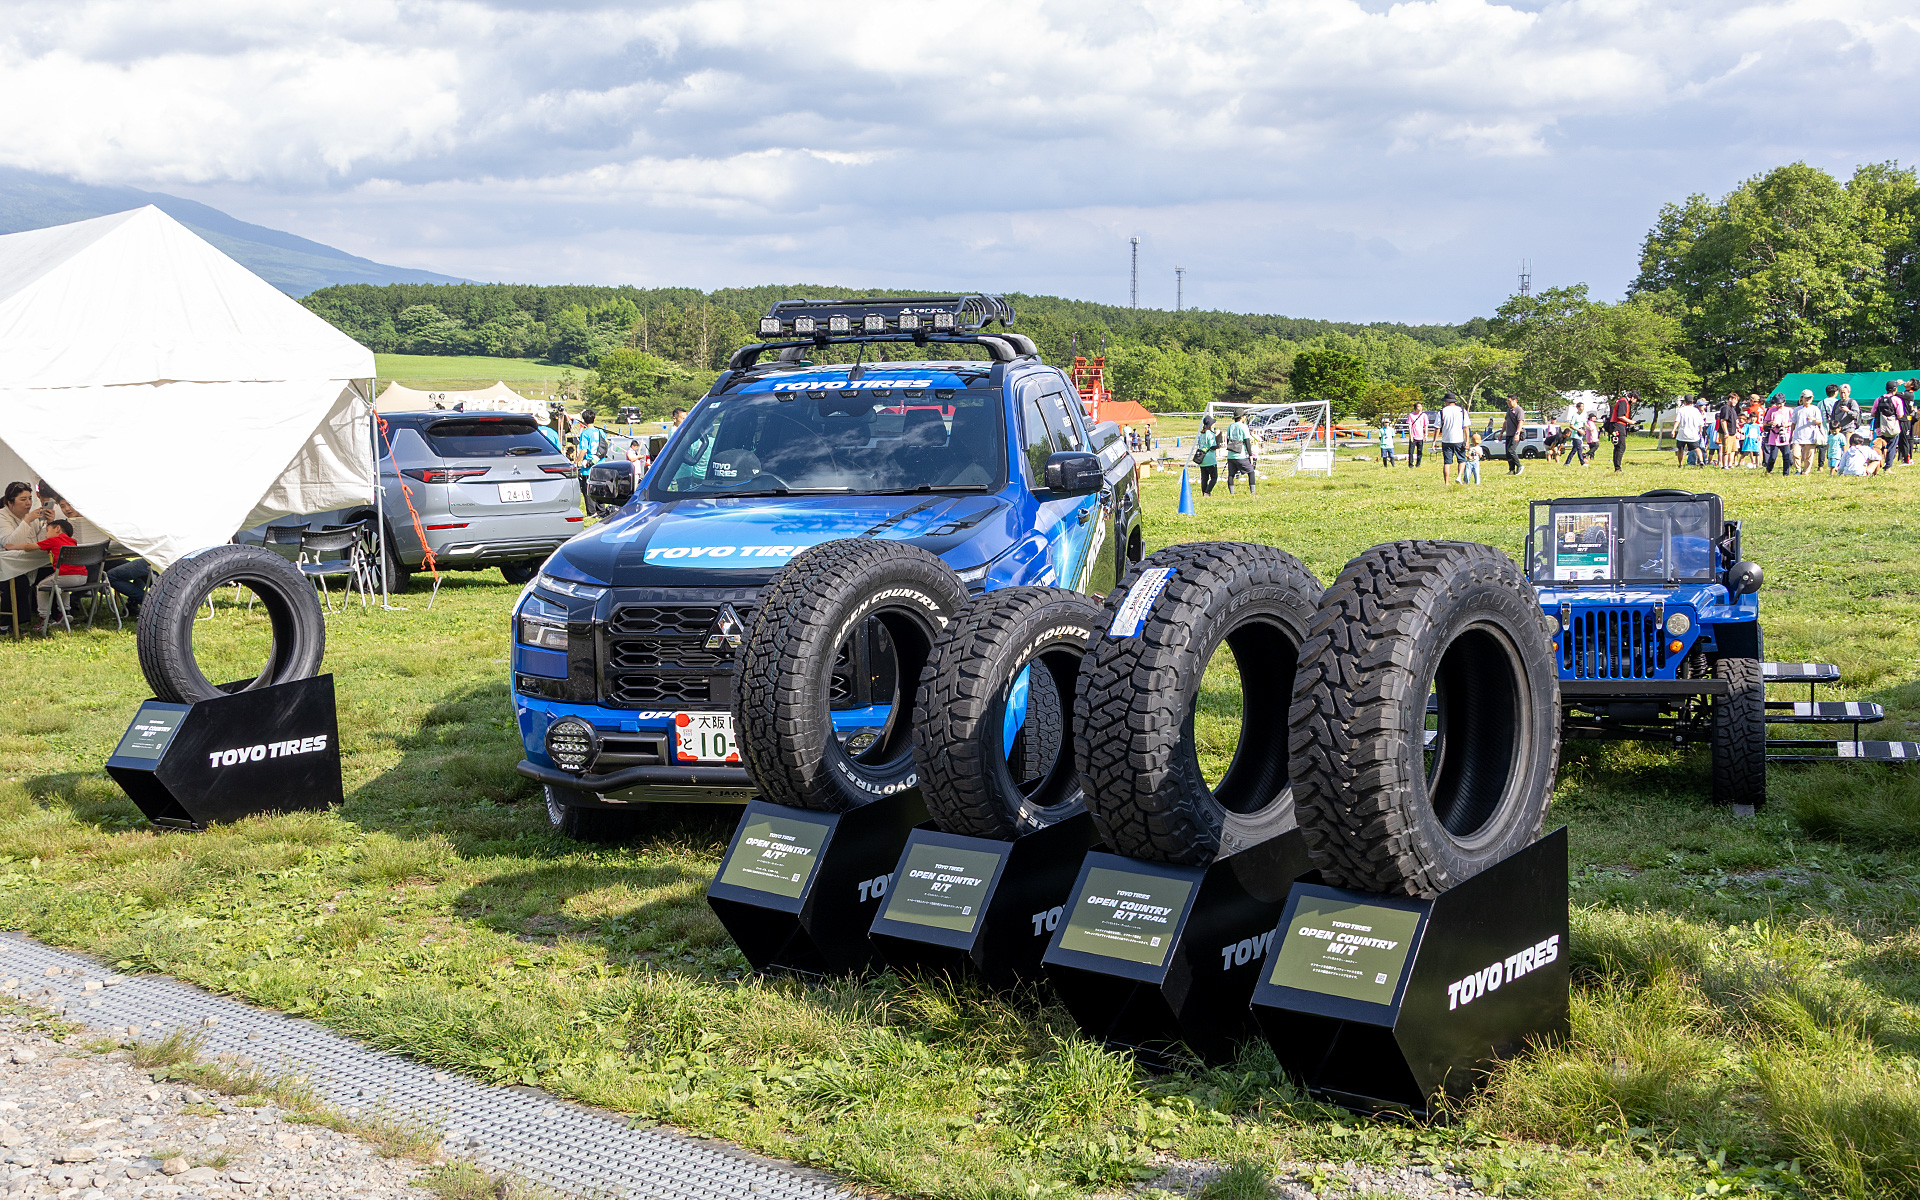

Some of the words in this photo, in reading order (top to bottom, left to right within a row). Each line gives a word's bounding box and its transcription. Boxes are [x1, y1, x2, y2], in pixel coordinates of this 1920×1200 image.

[772, 380, 851, 391] TOYO
[849, 379, 933, 389] TIRES
[713, 462, 731, 470] TOYO
[715, 469, 738, 477] TIRES
[645, 546, 738, 560] TOYO
[833, 600, 871, 650] OPEN
[871, 588, 940, 612] COUNTRY
[698, 716, 725, 729] 大阪
[209, 744, 267, 768] TOYO
[268, 735, 327, 758] TIRES
[683, 738, 693, 750] と
[837, 761, 882, 795] TIRES
[883, 773, 919, 795] OYO
[1018, 806, 1049, 830] RES
[745, 837, 771, 848] OPEN
[770, 842, 811, 856] COUNTRY
[909, 869, 937, 880] OPEN
[936, 873, 982, 886] COUNTRY
[858, 872, 894, 903] TO
[930, 881, 953, 893] R/T
[1116, 890, 1133, 898] TOYO
[1132, 892, 1151, 900] TIRES
[1087, 895, 1119, 908] OPEN
[1119, 900, 1172, 916] COUNTRY
[1032, 904, 1066, 937] TO
[1112, 909, 1138, 922] R/T
[1136, 913, 1168, 924] TRAIL
[1332, 920, 1351, 930] TOYO
[1350, 923, 1372, 932] TIRES
[1298, 926, 1336, 940] OPEN
[1336, 932, 1398, 950] COUNTRY
[1326, 942, 1359, 956] M/T
[1447, 961, 1503, 1011] TOYO
[1504, 934, 1560, 984] TIRES
